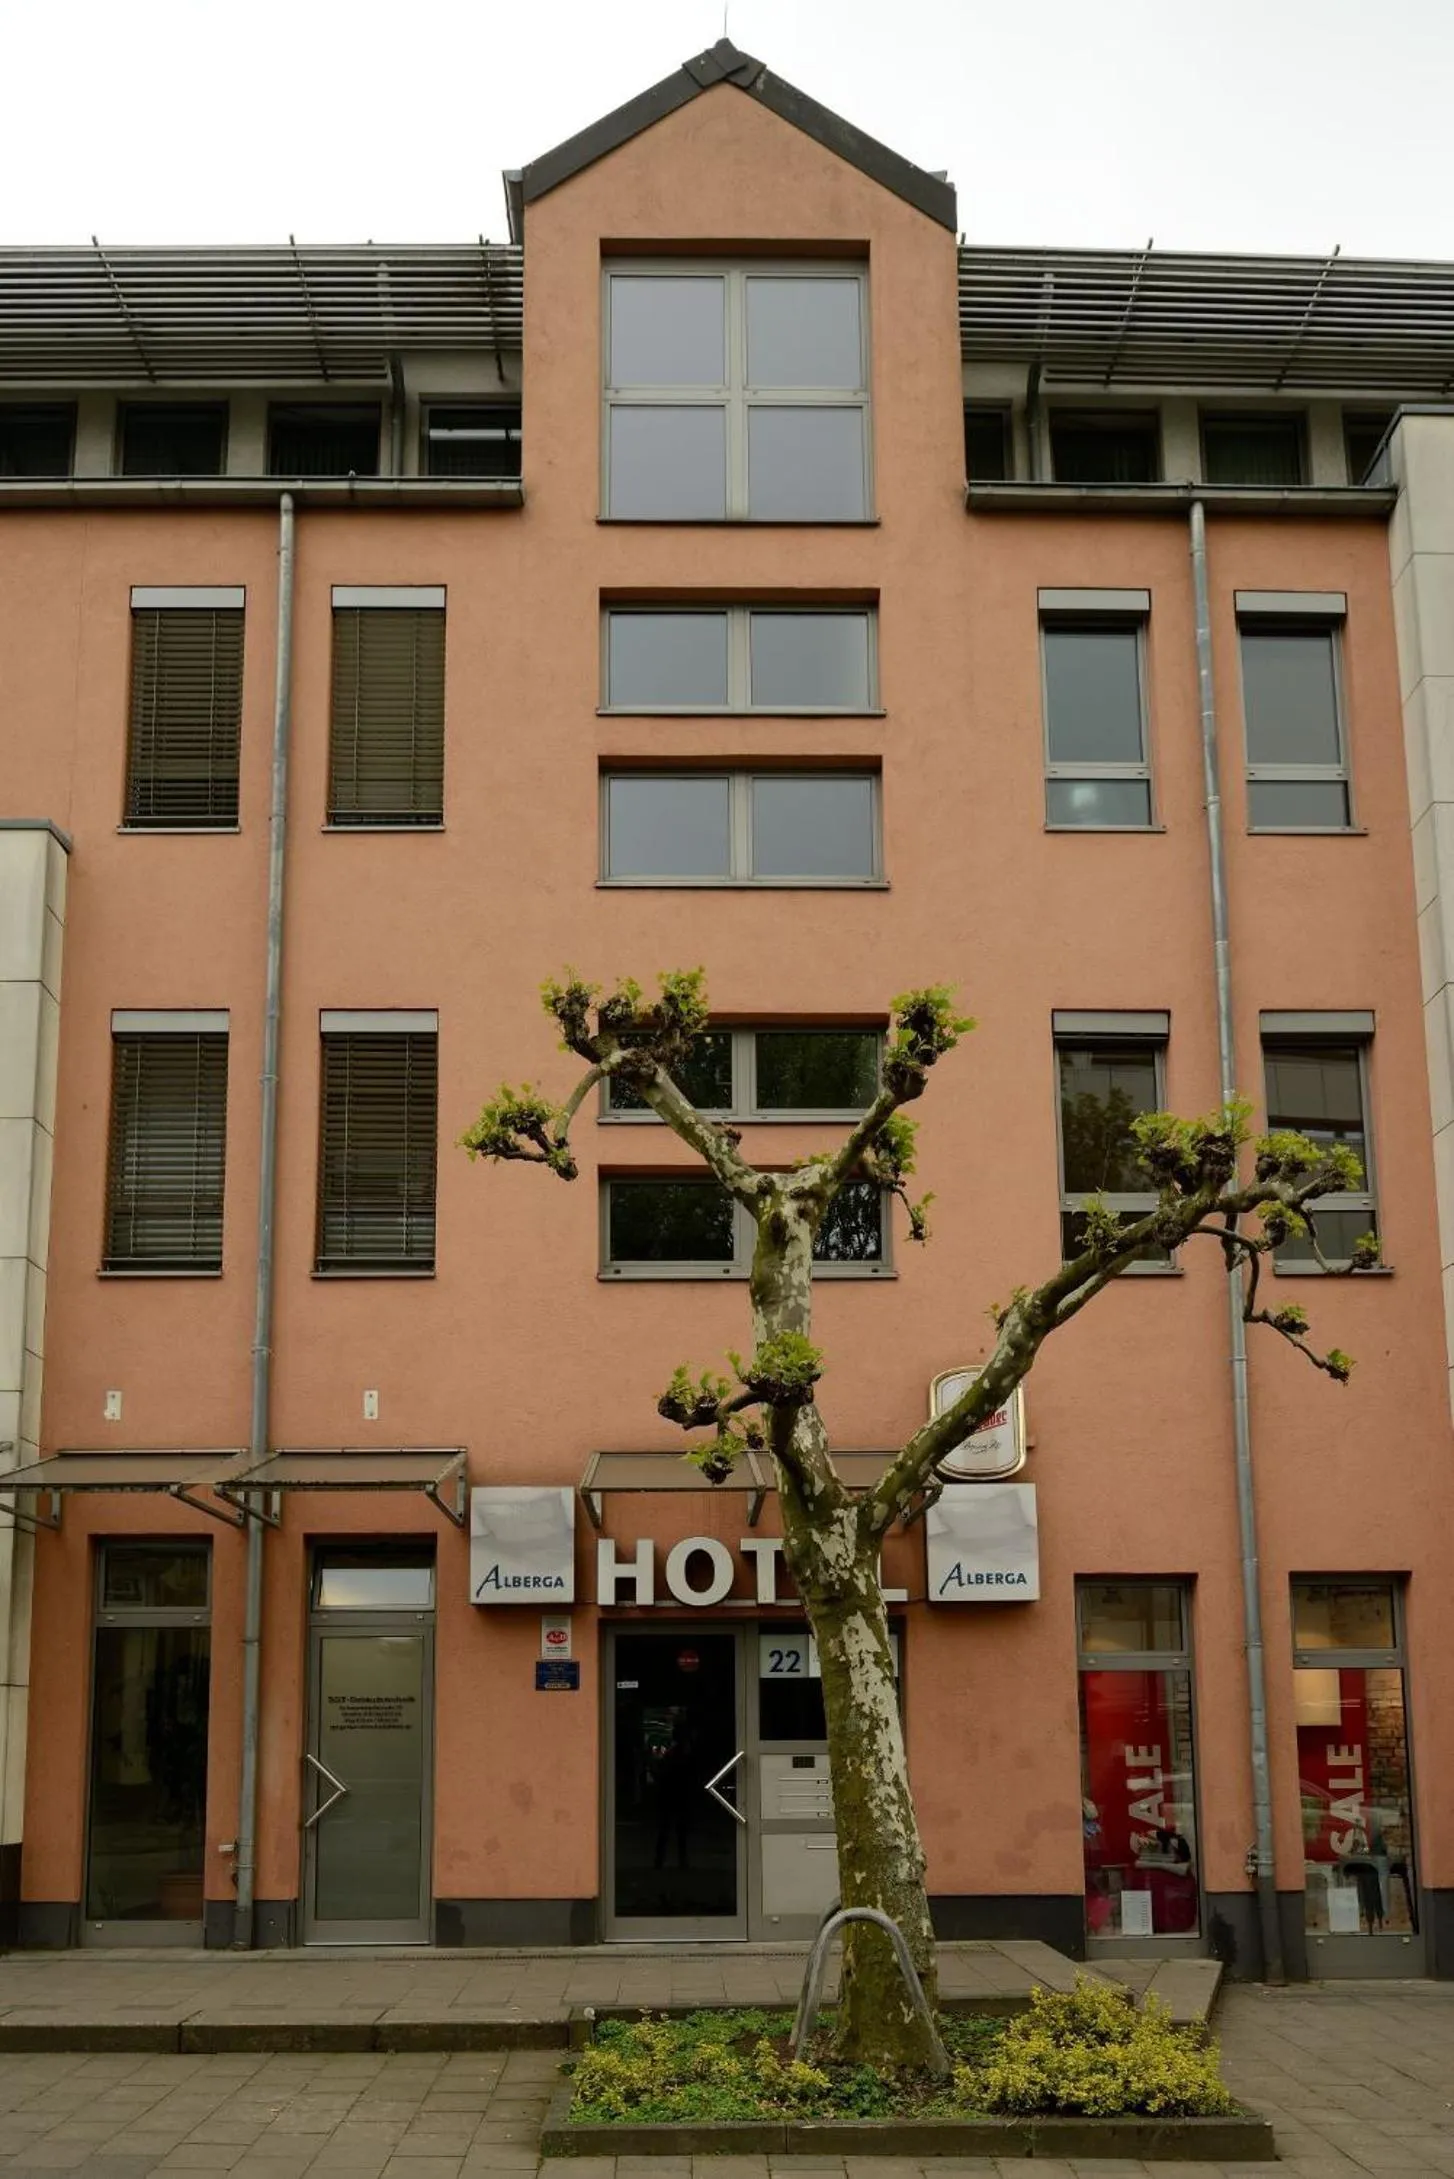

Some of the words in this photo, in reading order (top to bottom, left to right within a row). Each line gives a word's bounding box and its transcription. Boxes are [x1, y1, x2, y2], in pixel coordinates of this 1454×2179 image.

[476, 1564, 564, 1598] ALBERGA
[597, 1537, 908, 1606] HOTL
[939, 1562, 1027, 1595] ALBERGA
[769, 1650, 801, 1673] 22
[1326, 1743, 1369, 1857] SALE
